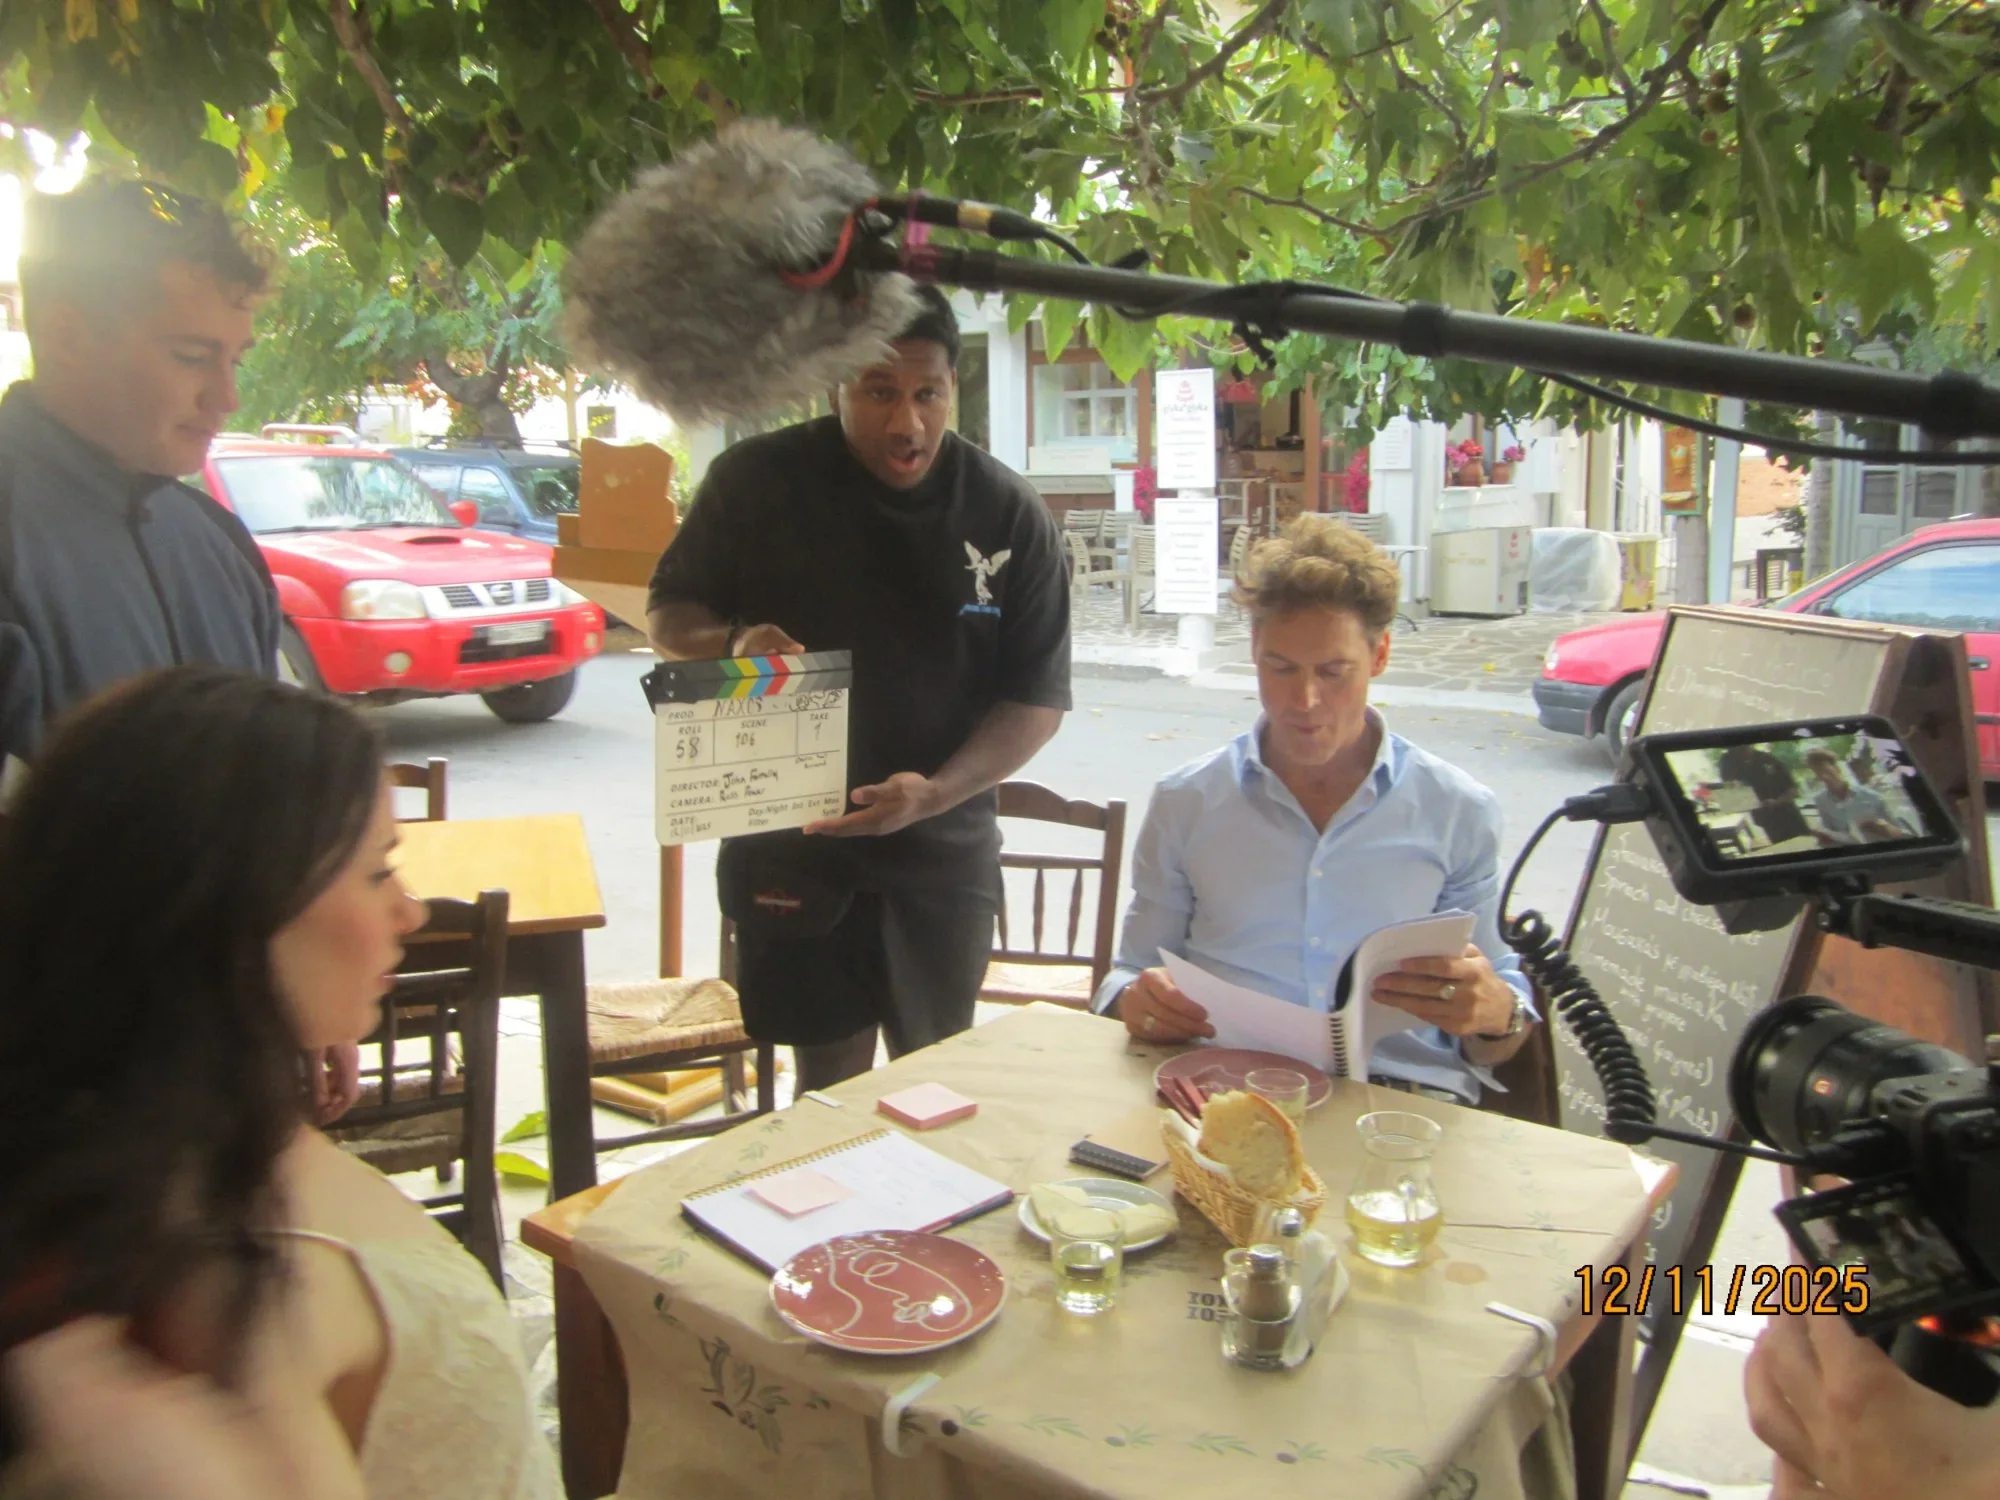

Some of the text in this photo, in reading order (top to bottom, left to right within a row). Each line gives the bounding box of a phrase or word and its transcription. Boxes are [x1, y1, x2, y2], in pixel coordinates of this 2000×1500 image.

[809, 712, 829, 722] TAKE
[741, 719, 768, 729] SCENE
[678, 725, 702, 735] ROLL
